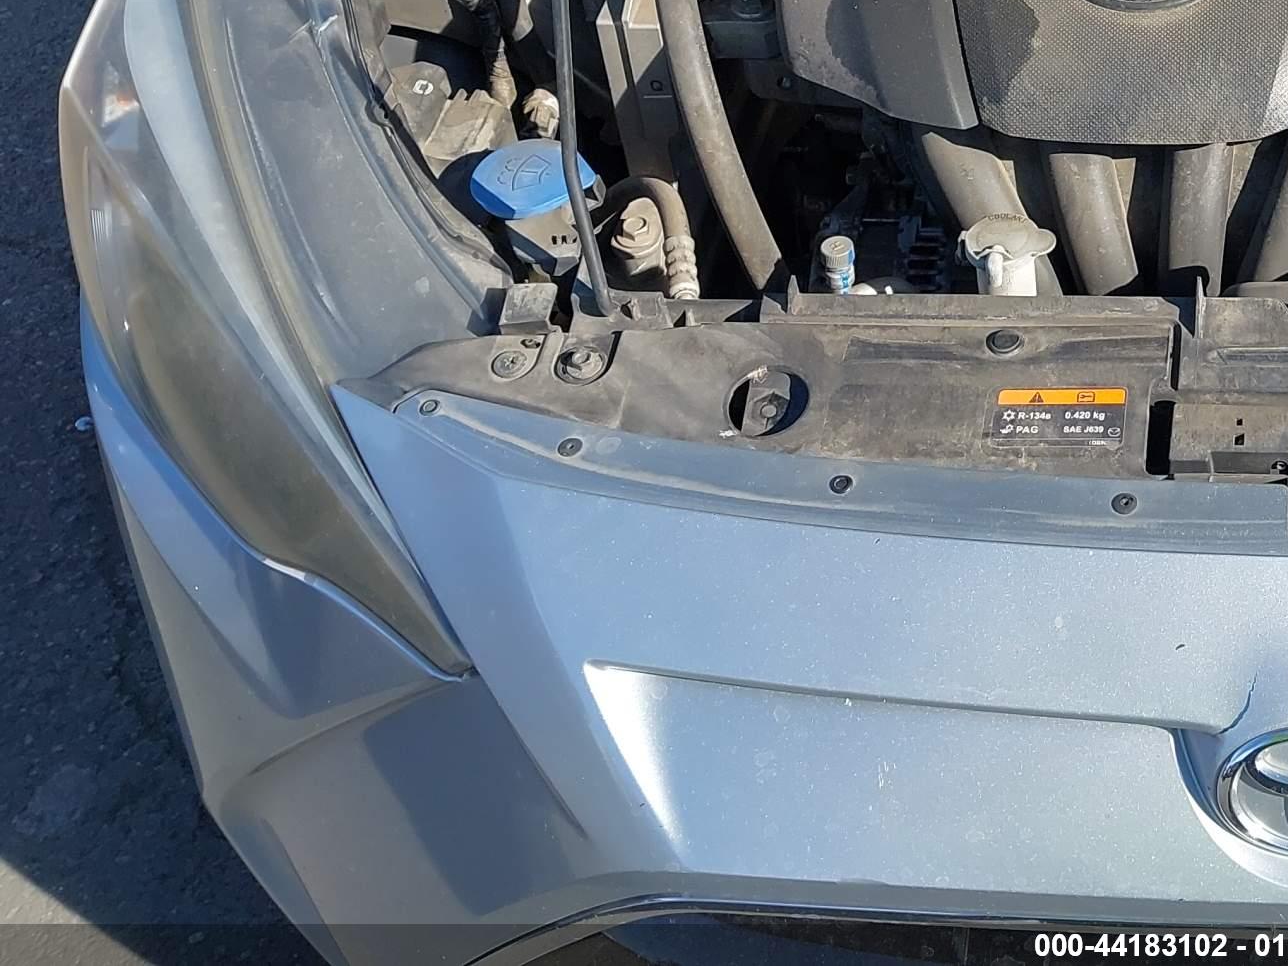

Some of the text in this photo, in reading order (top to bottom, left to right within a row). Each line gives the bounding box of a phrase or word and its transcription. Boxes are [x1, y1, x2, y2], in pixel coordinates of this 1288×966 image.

[1064, 410, 1092, 420] 0.420
[1093, 411, 1106, 421] kg
[1015, 425, 1105, 434] PAG SAE J639
